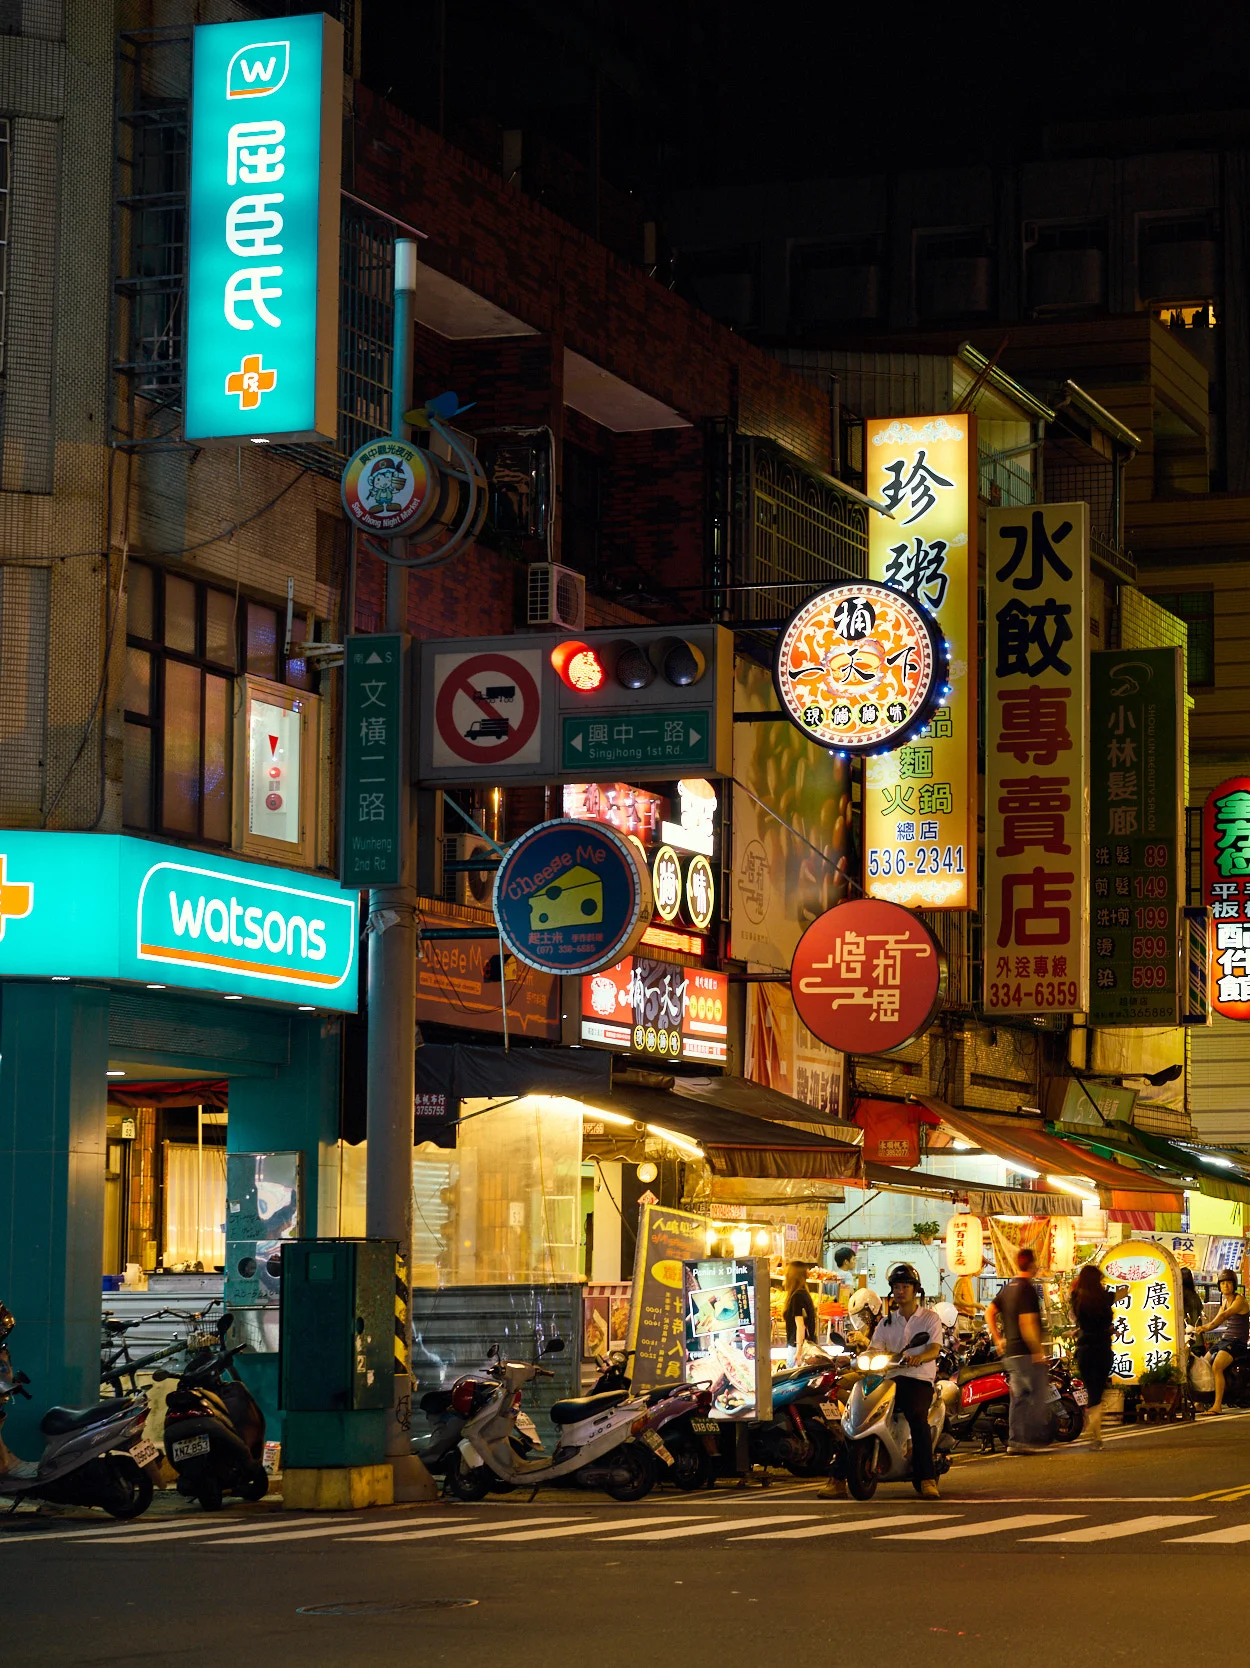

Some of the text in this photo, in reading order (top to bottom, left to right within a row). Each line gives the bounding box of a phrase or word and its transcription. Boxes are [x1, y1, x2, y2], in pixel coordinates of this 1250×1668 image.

[225, 120, 286, 331] 屈臣氏
[359, 444, 415, 466] 興中觀光夜市
[351, 498, 420, 529] Sing Jhong Night Market
[881, 450, 954, 610] 珍粥
[385, 651, 393, 664] S
[789, 647, 919, 684] 一天下
[588, 721, 685, 745] 興中一路
[996, 511, 1075, 948] 水餃專賣店
[359, 679, 387, 822] 文橫二路
[589, 745, 683, 760] Singjhong 1st Rd.
[899, 746, 933, 780] 麵
[1107, 704, 1138, 835] 小林髮廊
[1147, 755, 1156, 796] BEAUTY
[882, 783, 952, 816] 火鍋
[1147, 797, 1156, 831] SALON
[352, 838, 392, 853] Wunheng
[896, 821, 938, 841] 總店
[354, 857, 389, 871] 2nd Rd.
[576, 845, 606, 864] Me
[868, 845, 966, 876] 536-2341
[1095, 845, 1168, 868] 洗髮 89
[1095, 876, 1168, 900] 剪髮 149
[1211, 882, 1241, 918] 平板
[169, 890, 327, 961] watsons
[1135, 907, 1168, 929] 199
[1096, 936, 1166, 960] 燙 599
[996, 955, 1068, 980] 外送專線
[1096, 966, 1166, 989] 染 599
[990, 980, 1078, 1009] 334-6359
[726, 1265, 748, 1275] Drink
[1142, 1281, 1173, 1371] 廣東粥
